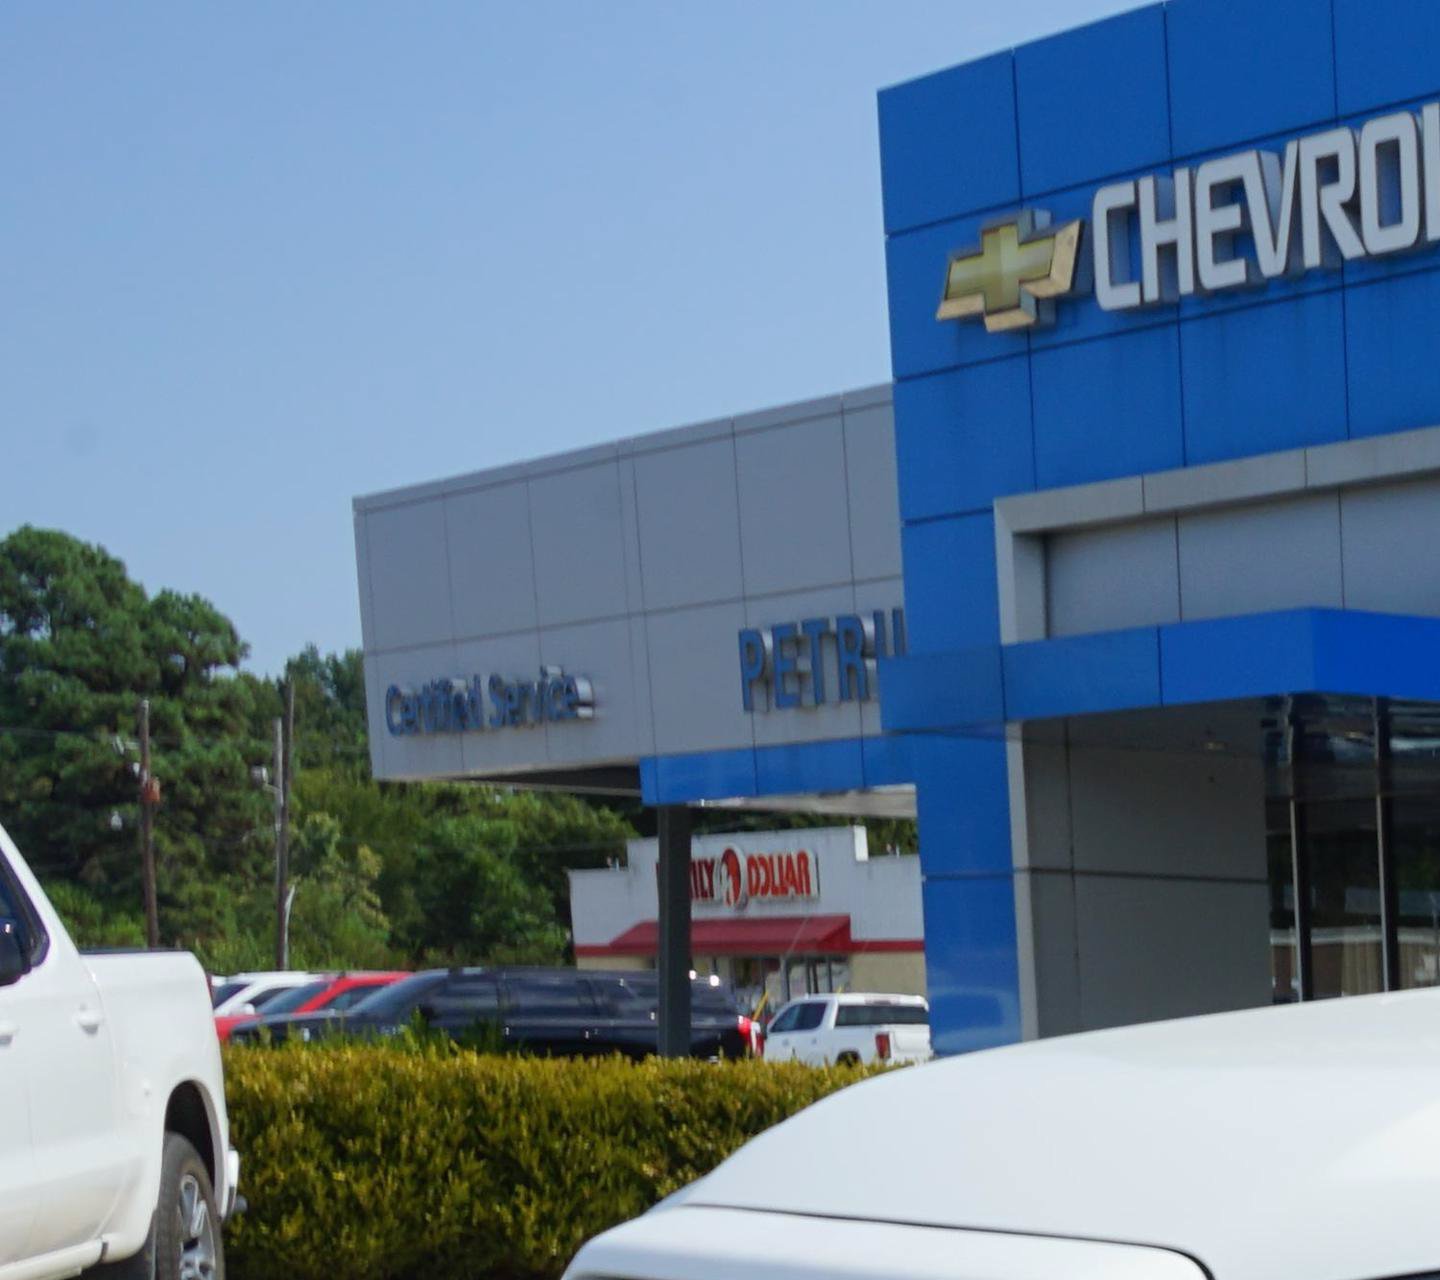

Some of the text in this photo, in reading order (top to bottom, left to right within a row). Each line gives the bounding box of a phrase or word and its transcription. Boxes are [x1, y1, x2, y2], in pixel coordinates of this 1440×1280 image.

[385, 665, 592, 738] Certified Service
[746, 850, 813, 897] DOLLAR
